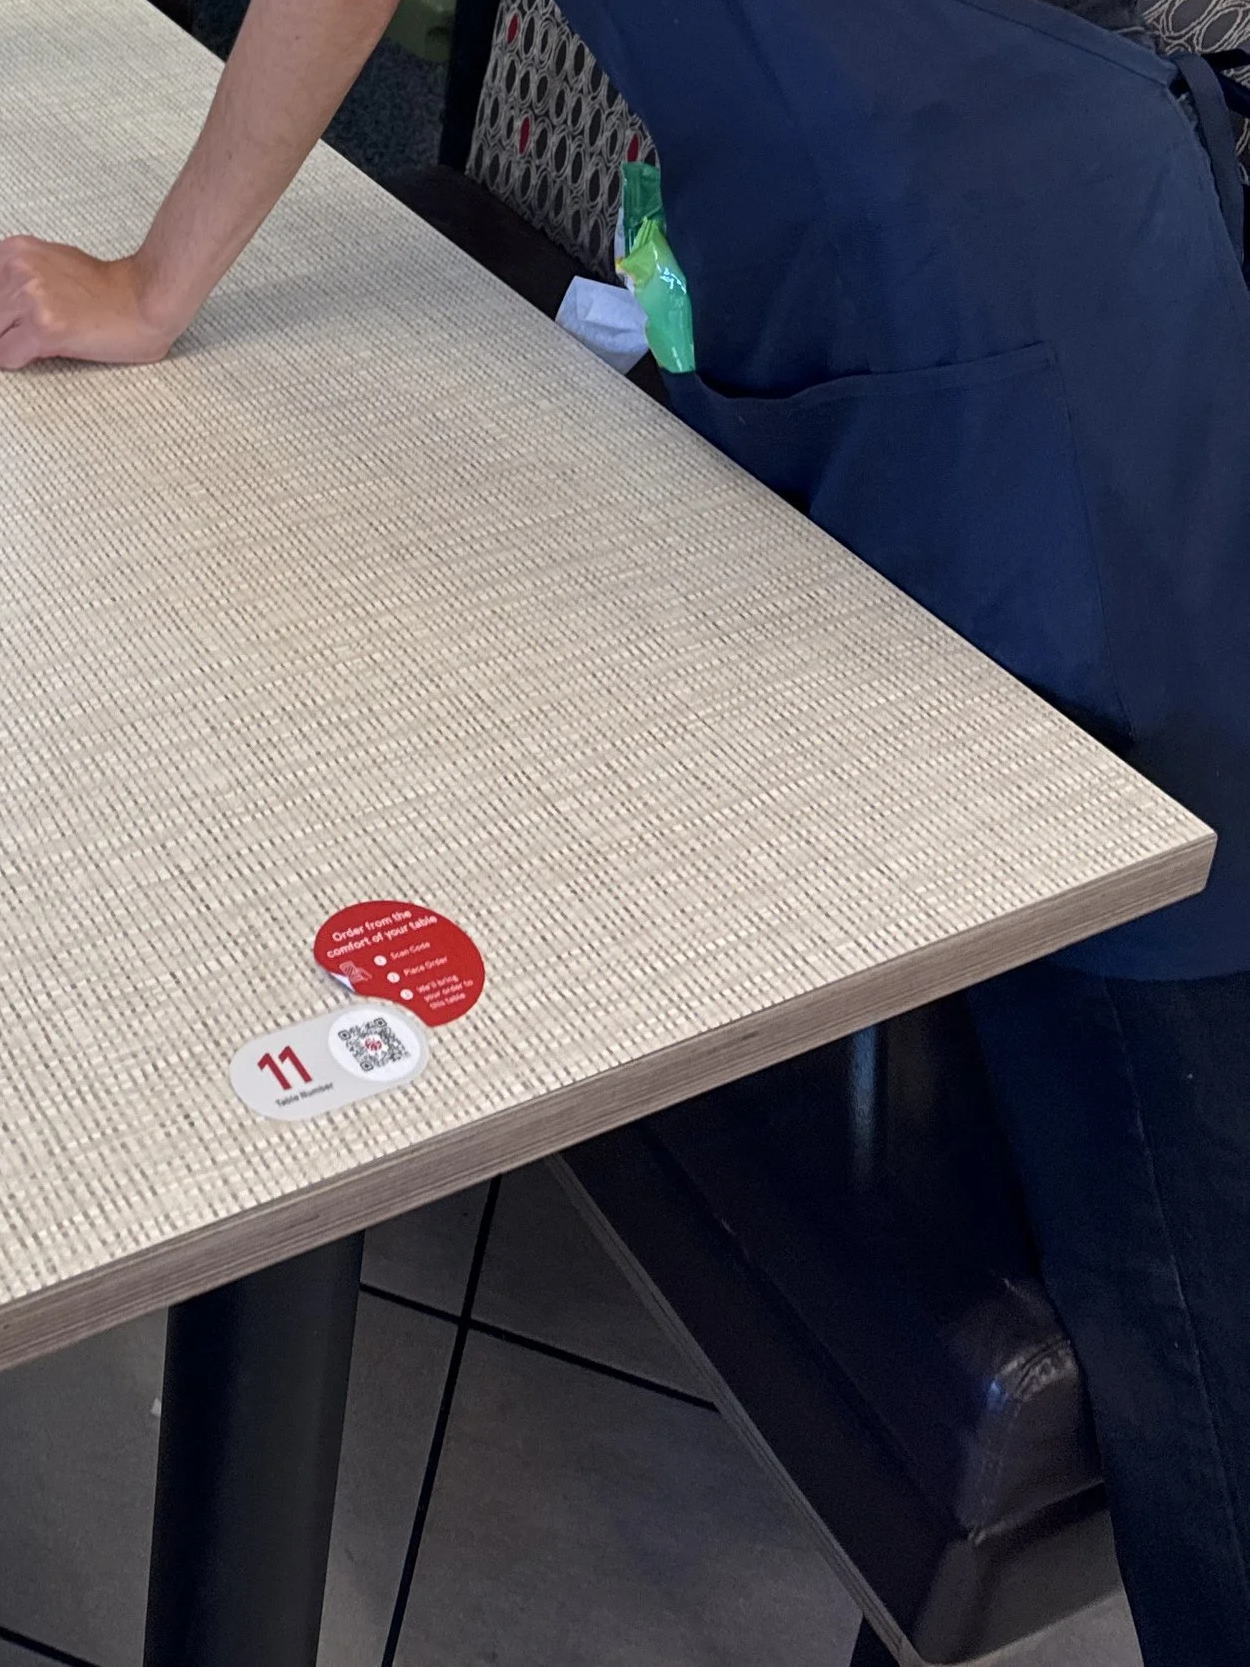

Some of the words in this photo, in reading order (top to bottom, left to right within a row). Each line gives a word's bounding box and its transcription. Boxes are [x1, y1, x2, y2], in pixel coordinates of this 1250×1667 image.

[326, 936, 372, 959] comfort
[371, 931, 384, 943] of
[384, 924, 408, 941] your
[408, 915, 438, 931] table
[332, 925, 364, 942] Order
[364, 917, 393, 931] from
[391, 910, 412, 922] the
[390, 948, 410, 961] Scan
[409, 941, 430, 954] Code
[403, 964, 425, 976] Place
[424, 956, 448, 969] Order
[424, 990, 441, 1002] your
[441, 982, 463, 995] order
[463, 979, 474, 987] to
[436, 974, 459, 987] bring
[257, 1045, 313, 1091] 11
[275, 1094, 300, 1107] Table
[300, 1082, 334, 1099] Number
